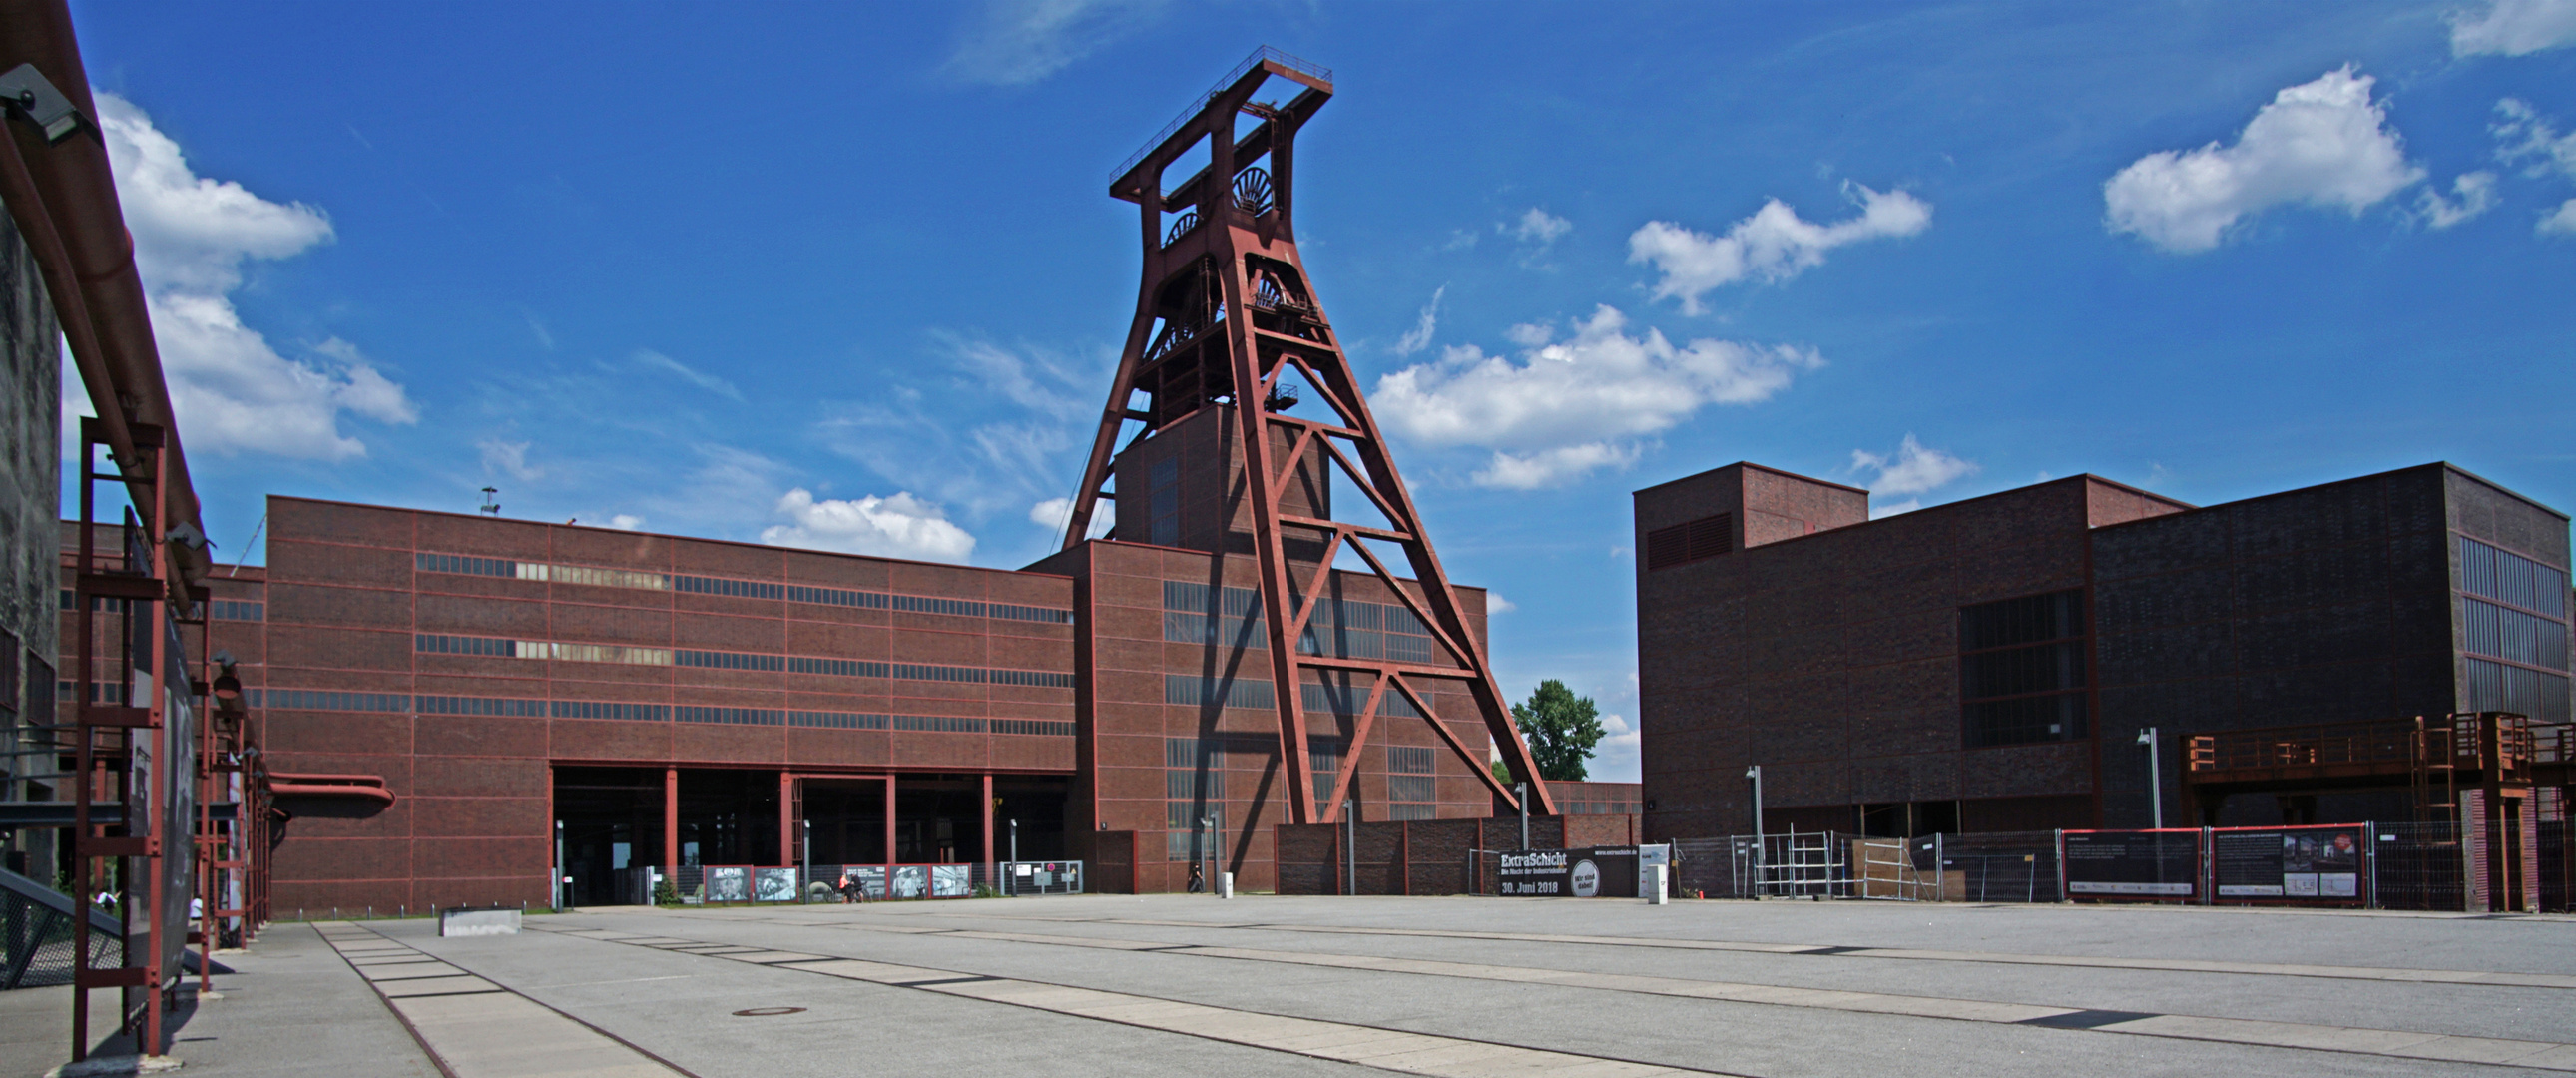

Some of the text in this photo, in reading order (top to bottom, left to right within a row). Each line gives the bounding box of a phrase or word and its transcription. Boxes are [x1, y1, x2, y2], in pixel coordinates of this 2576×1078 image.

[1501, 852, 1567, 867] ExtraSchicht
[1502, 882, 1558, 893] 30. Juni 2018
